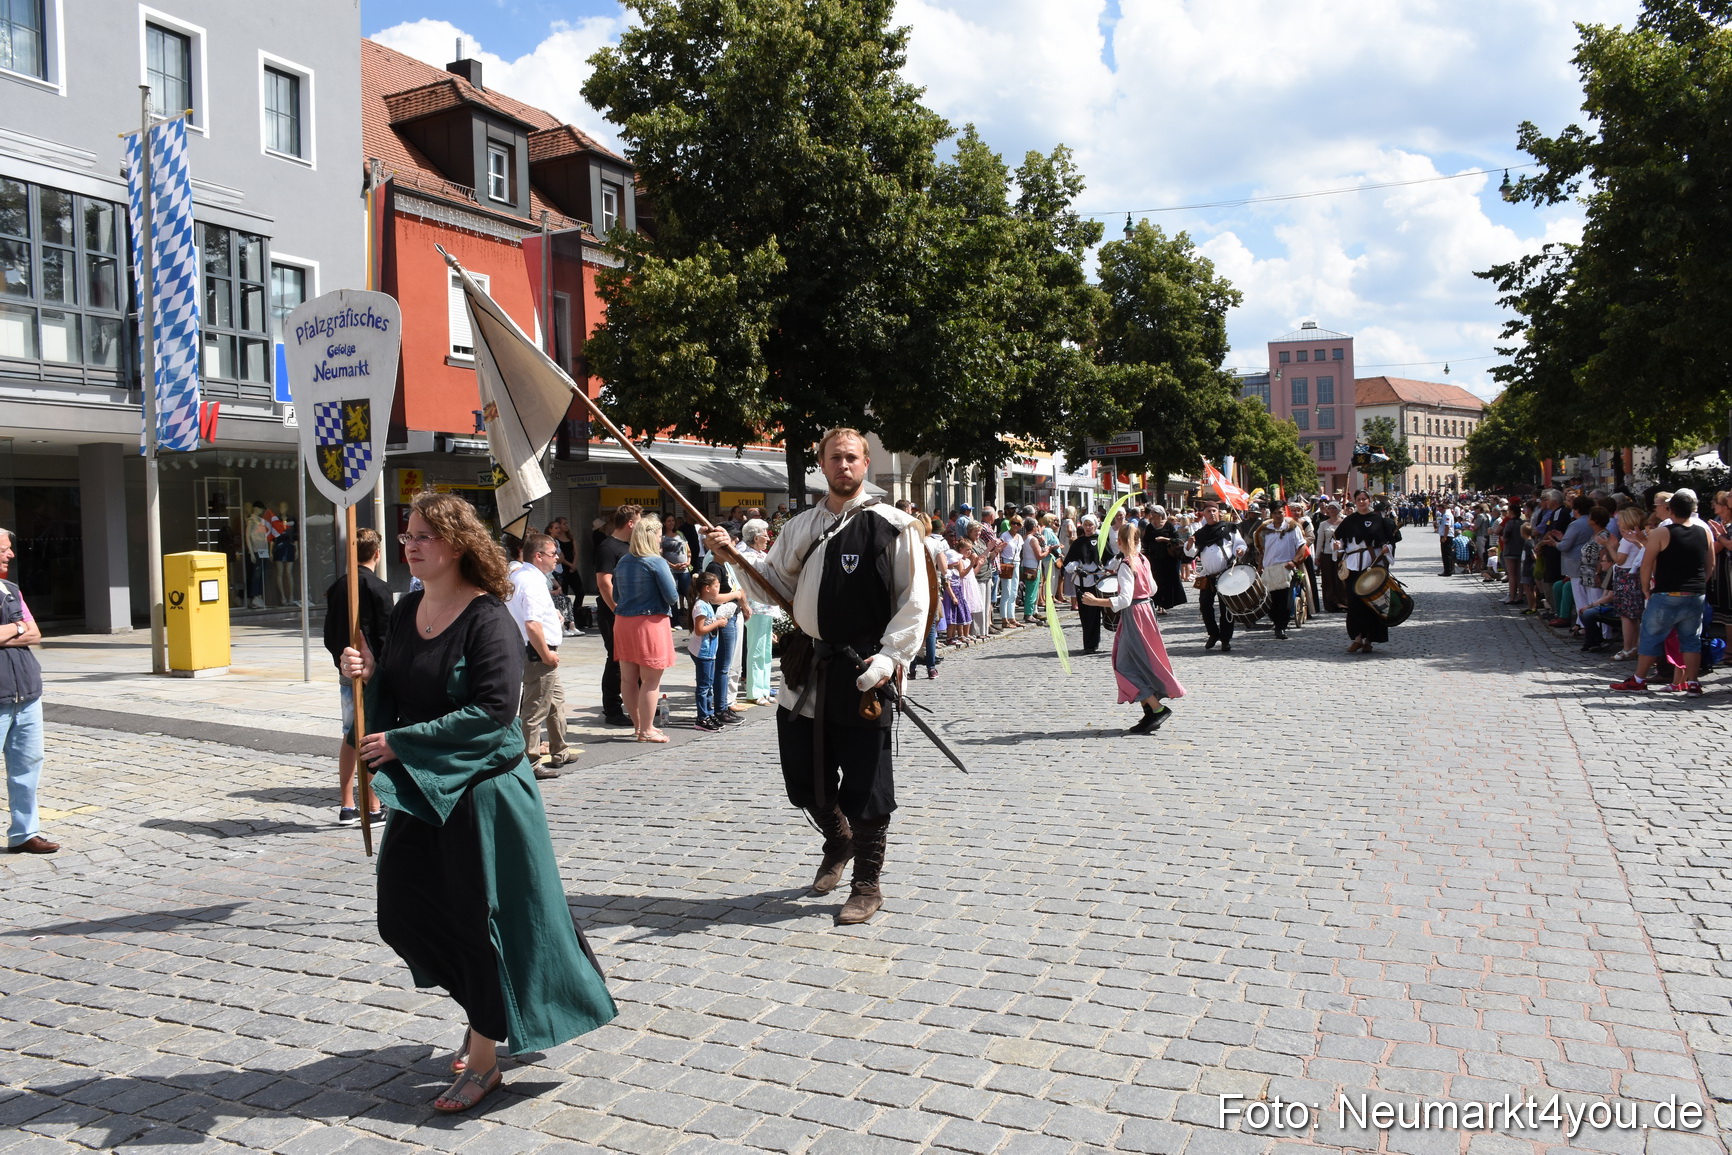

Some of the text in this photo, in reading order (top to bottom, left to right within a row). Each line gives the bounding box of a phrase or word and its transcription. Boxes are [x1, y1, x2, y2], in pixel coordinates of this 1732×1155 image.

[296, 306, 390, 345] Pfalzgräfisches
[326, 343, 356, 359] Gefolge
[313, 359, 370, 382] Neumarkt
